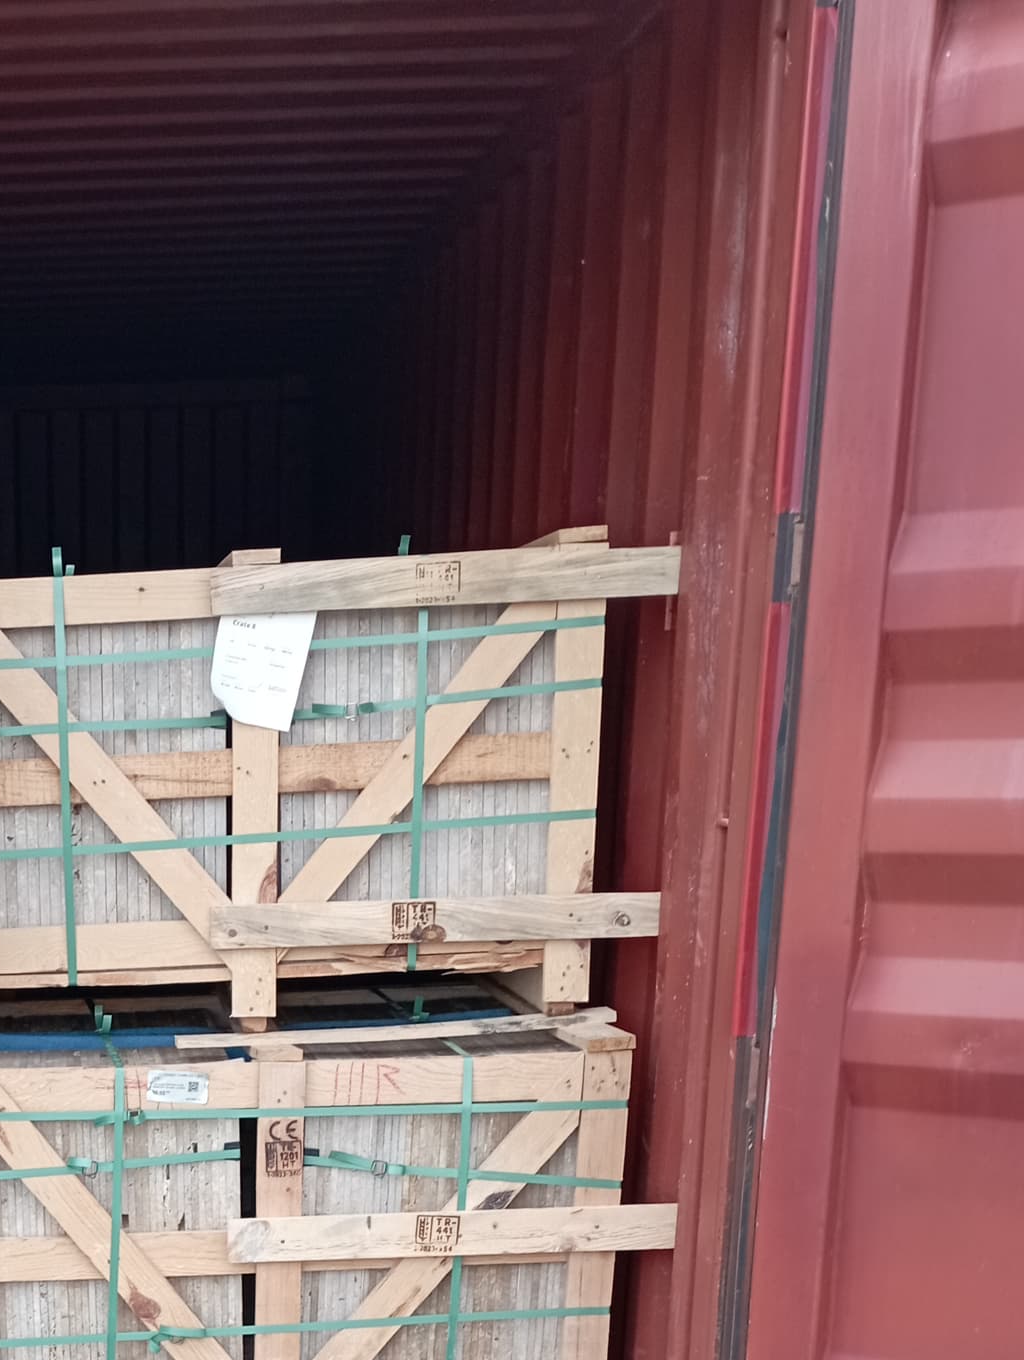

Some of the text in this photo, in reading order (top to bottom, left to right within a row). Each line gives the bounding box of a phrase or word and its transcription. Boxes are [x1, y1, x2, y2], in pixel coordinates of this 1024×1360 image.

[269, 1120, 298, 1140] CE
[280, 1151, 298, 1161] 1201
[282, 1160, 296, 1169] HT
[436, 1217, 457, 1226] TR-
